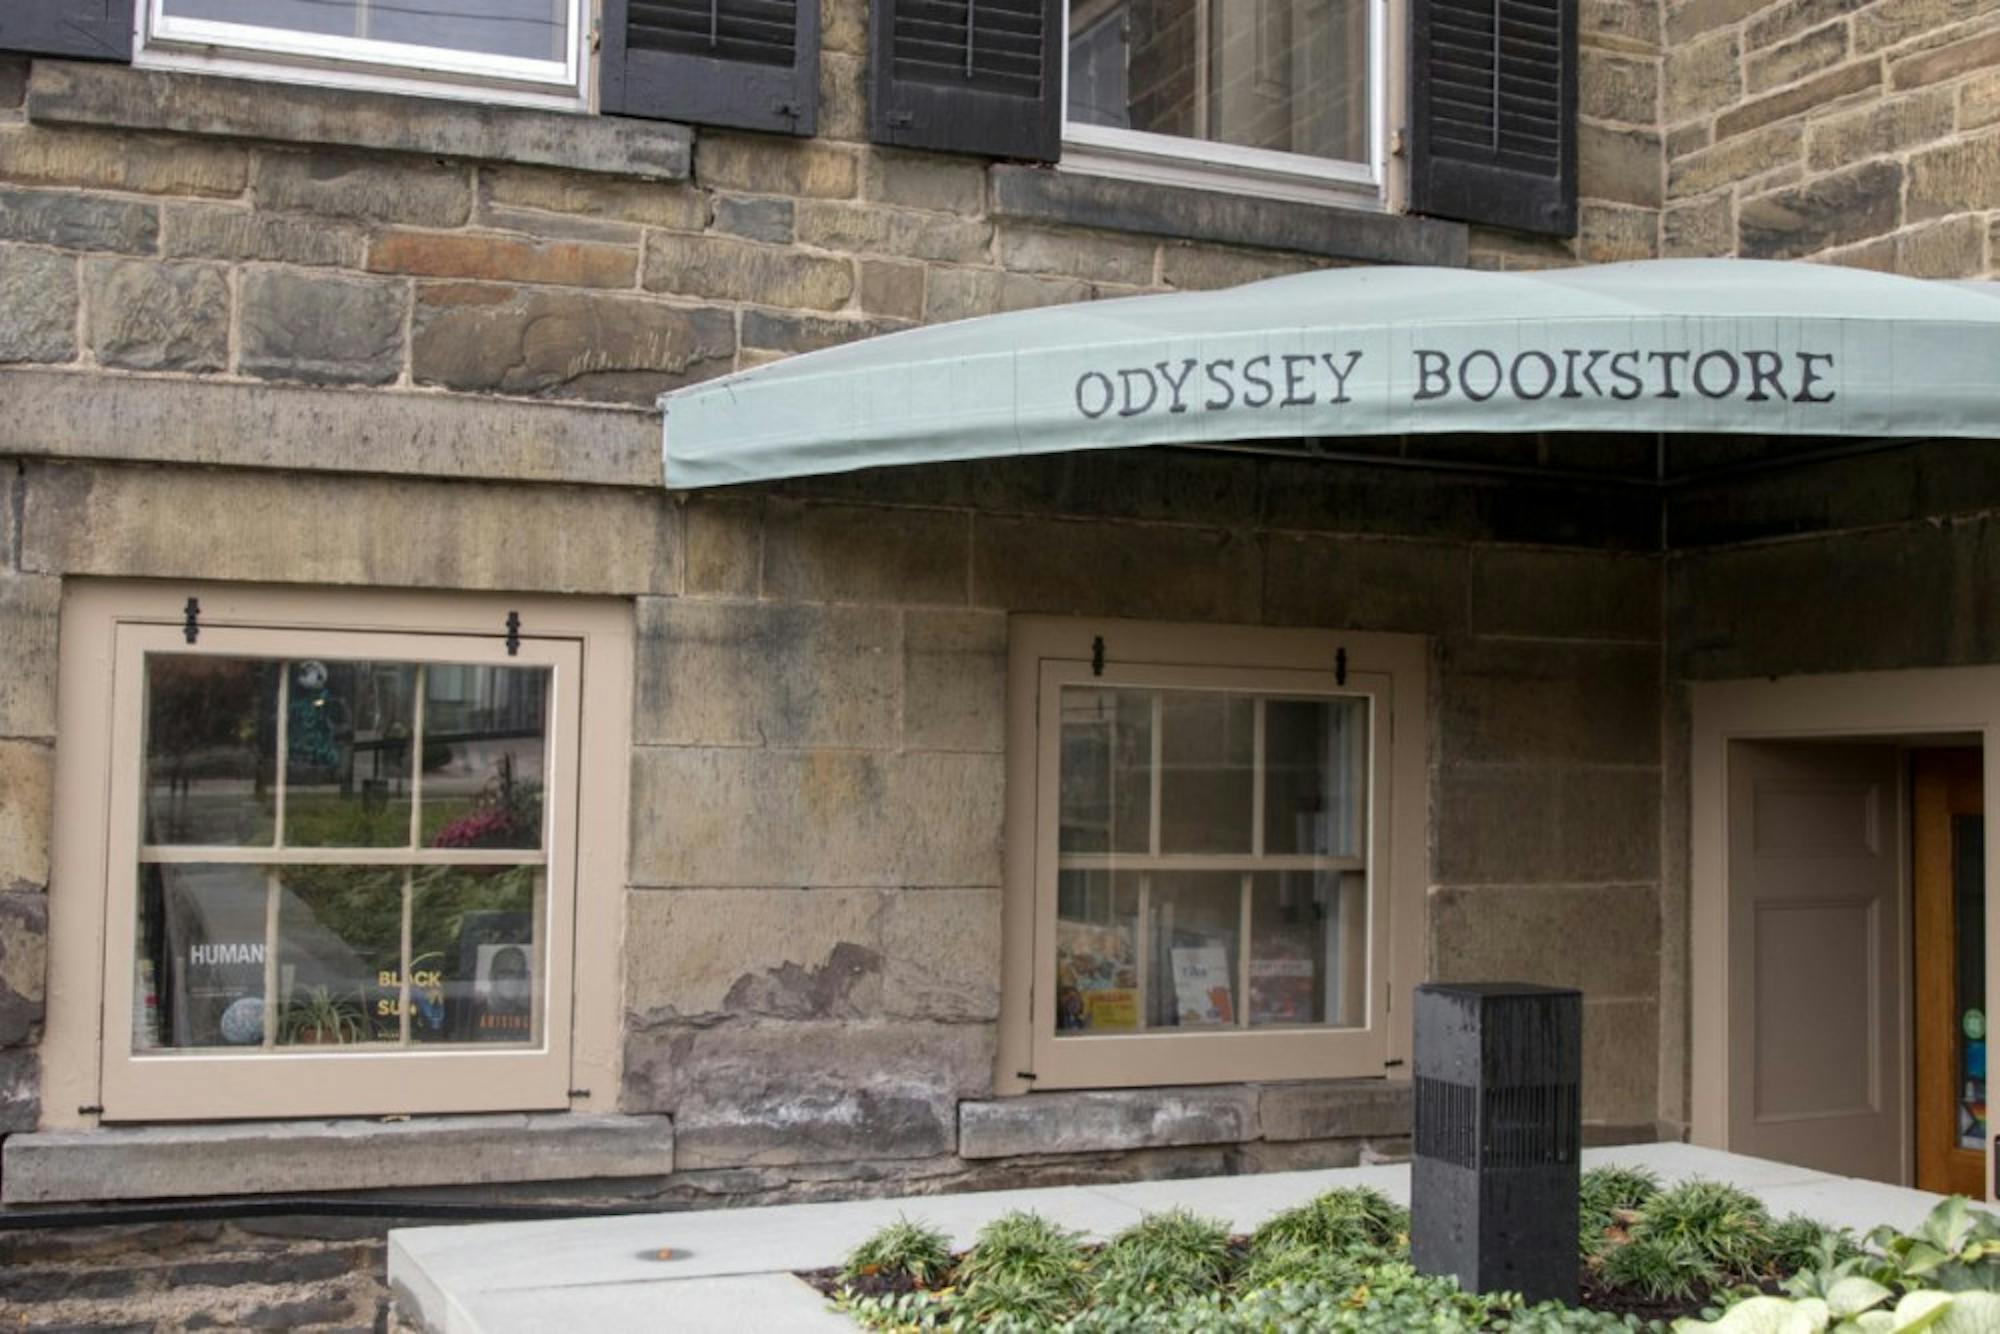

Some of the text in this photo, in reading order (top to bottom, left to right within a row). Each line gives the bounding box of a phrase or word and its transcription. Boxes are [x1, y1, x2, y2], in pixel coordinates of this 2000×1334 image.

[1075, 349, 1836, 419] ODYSSEY BOOKSTORE
[191, 943, 267, 966] HUMAN
